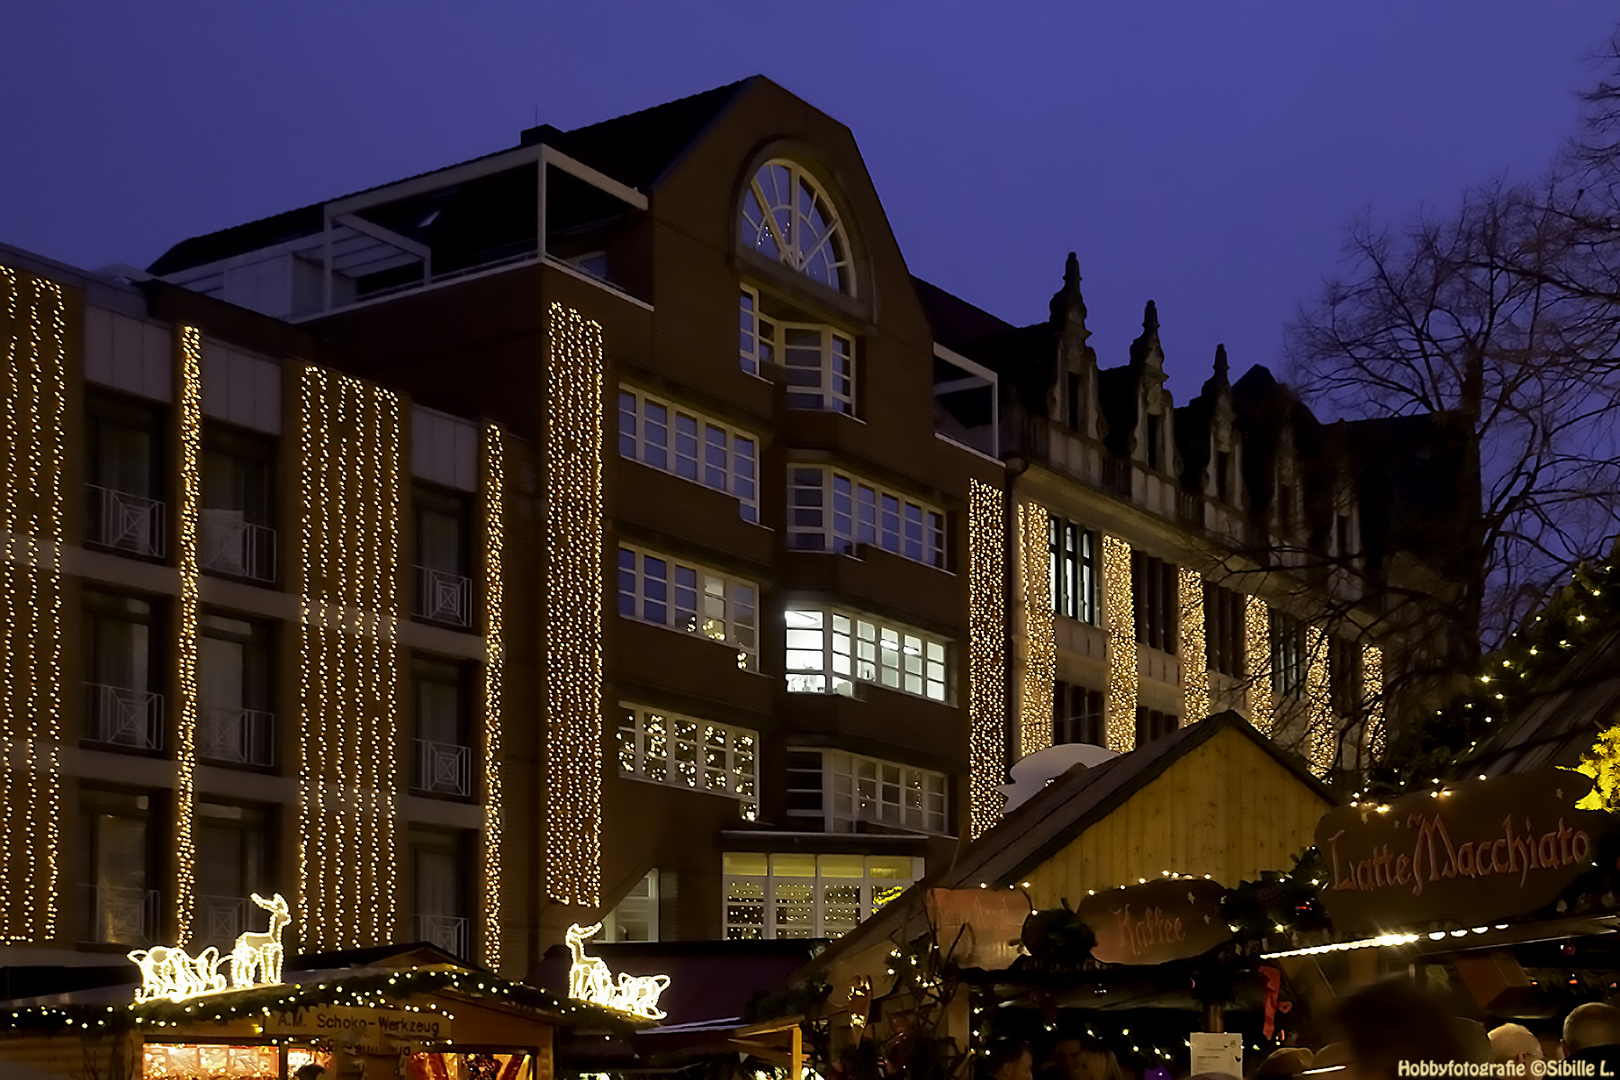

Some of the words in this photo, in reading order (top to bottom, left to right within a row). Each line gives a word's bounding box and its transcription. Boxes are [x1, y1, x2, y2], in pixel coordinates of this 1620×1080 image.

[1326, 829, 1411, 892] Latte
[1407, 813, 1591, 896] Macchiato
[1110, 902, 1188, 957] Kaffee
[317, 1013, 439, 1036] Schoko-Werkzeug
